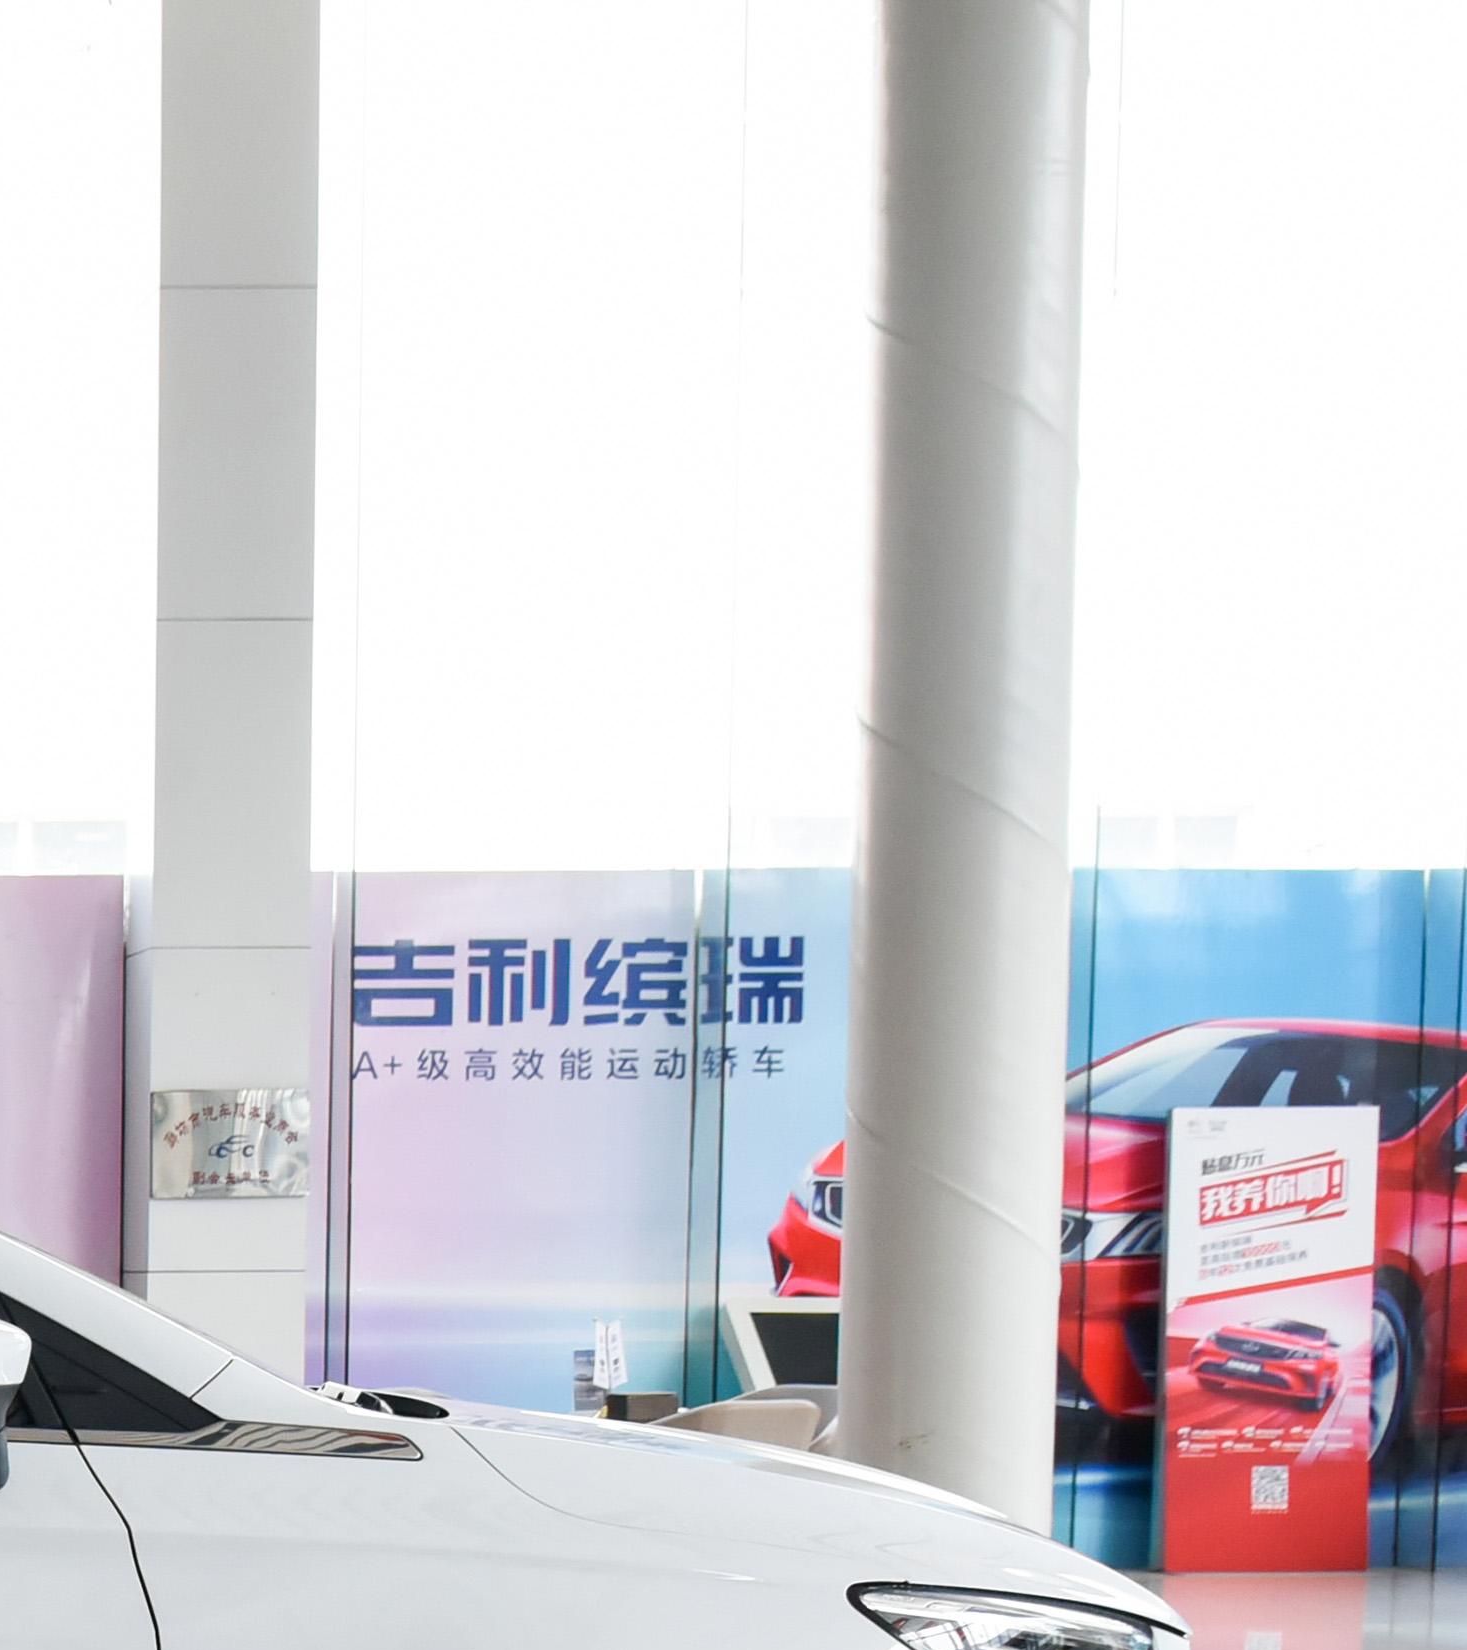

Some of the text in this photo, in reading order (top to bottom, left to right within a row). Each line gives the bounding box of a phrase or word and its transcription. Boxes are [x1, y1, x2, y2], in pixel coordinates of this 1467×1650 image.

[352, 936, 805, 1027] 吉利缤瑞
[352, 1047, 786, 1081] A+级高效能运动轿车
